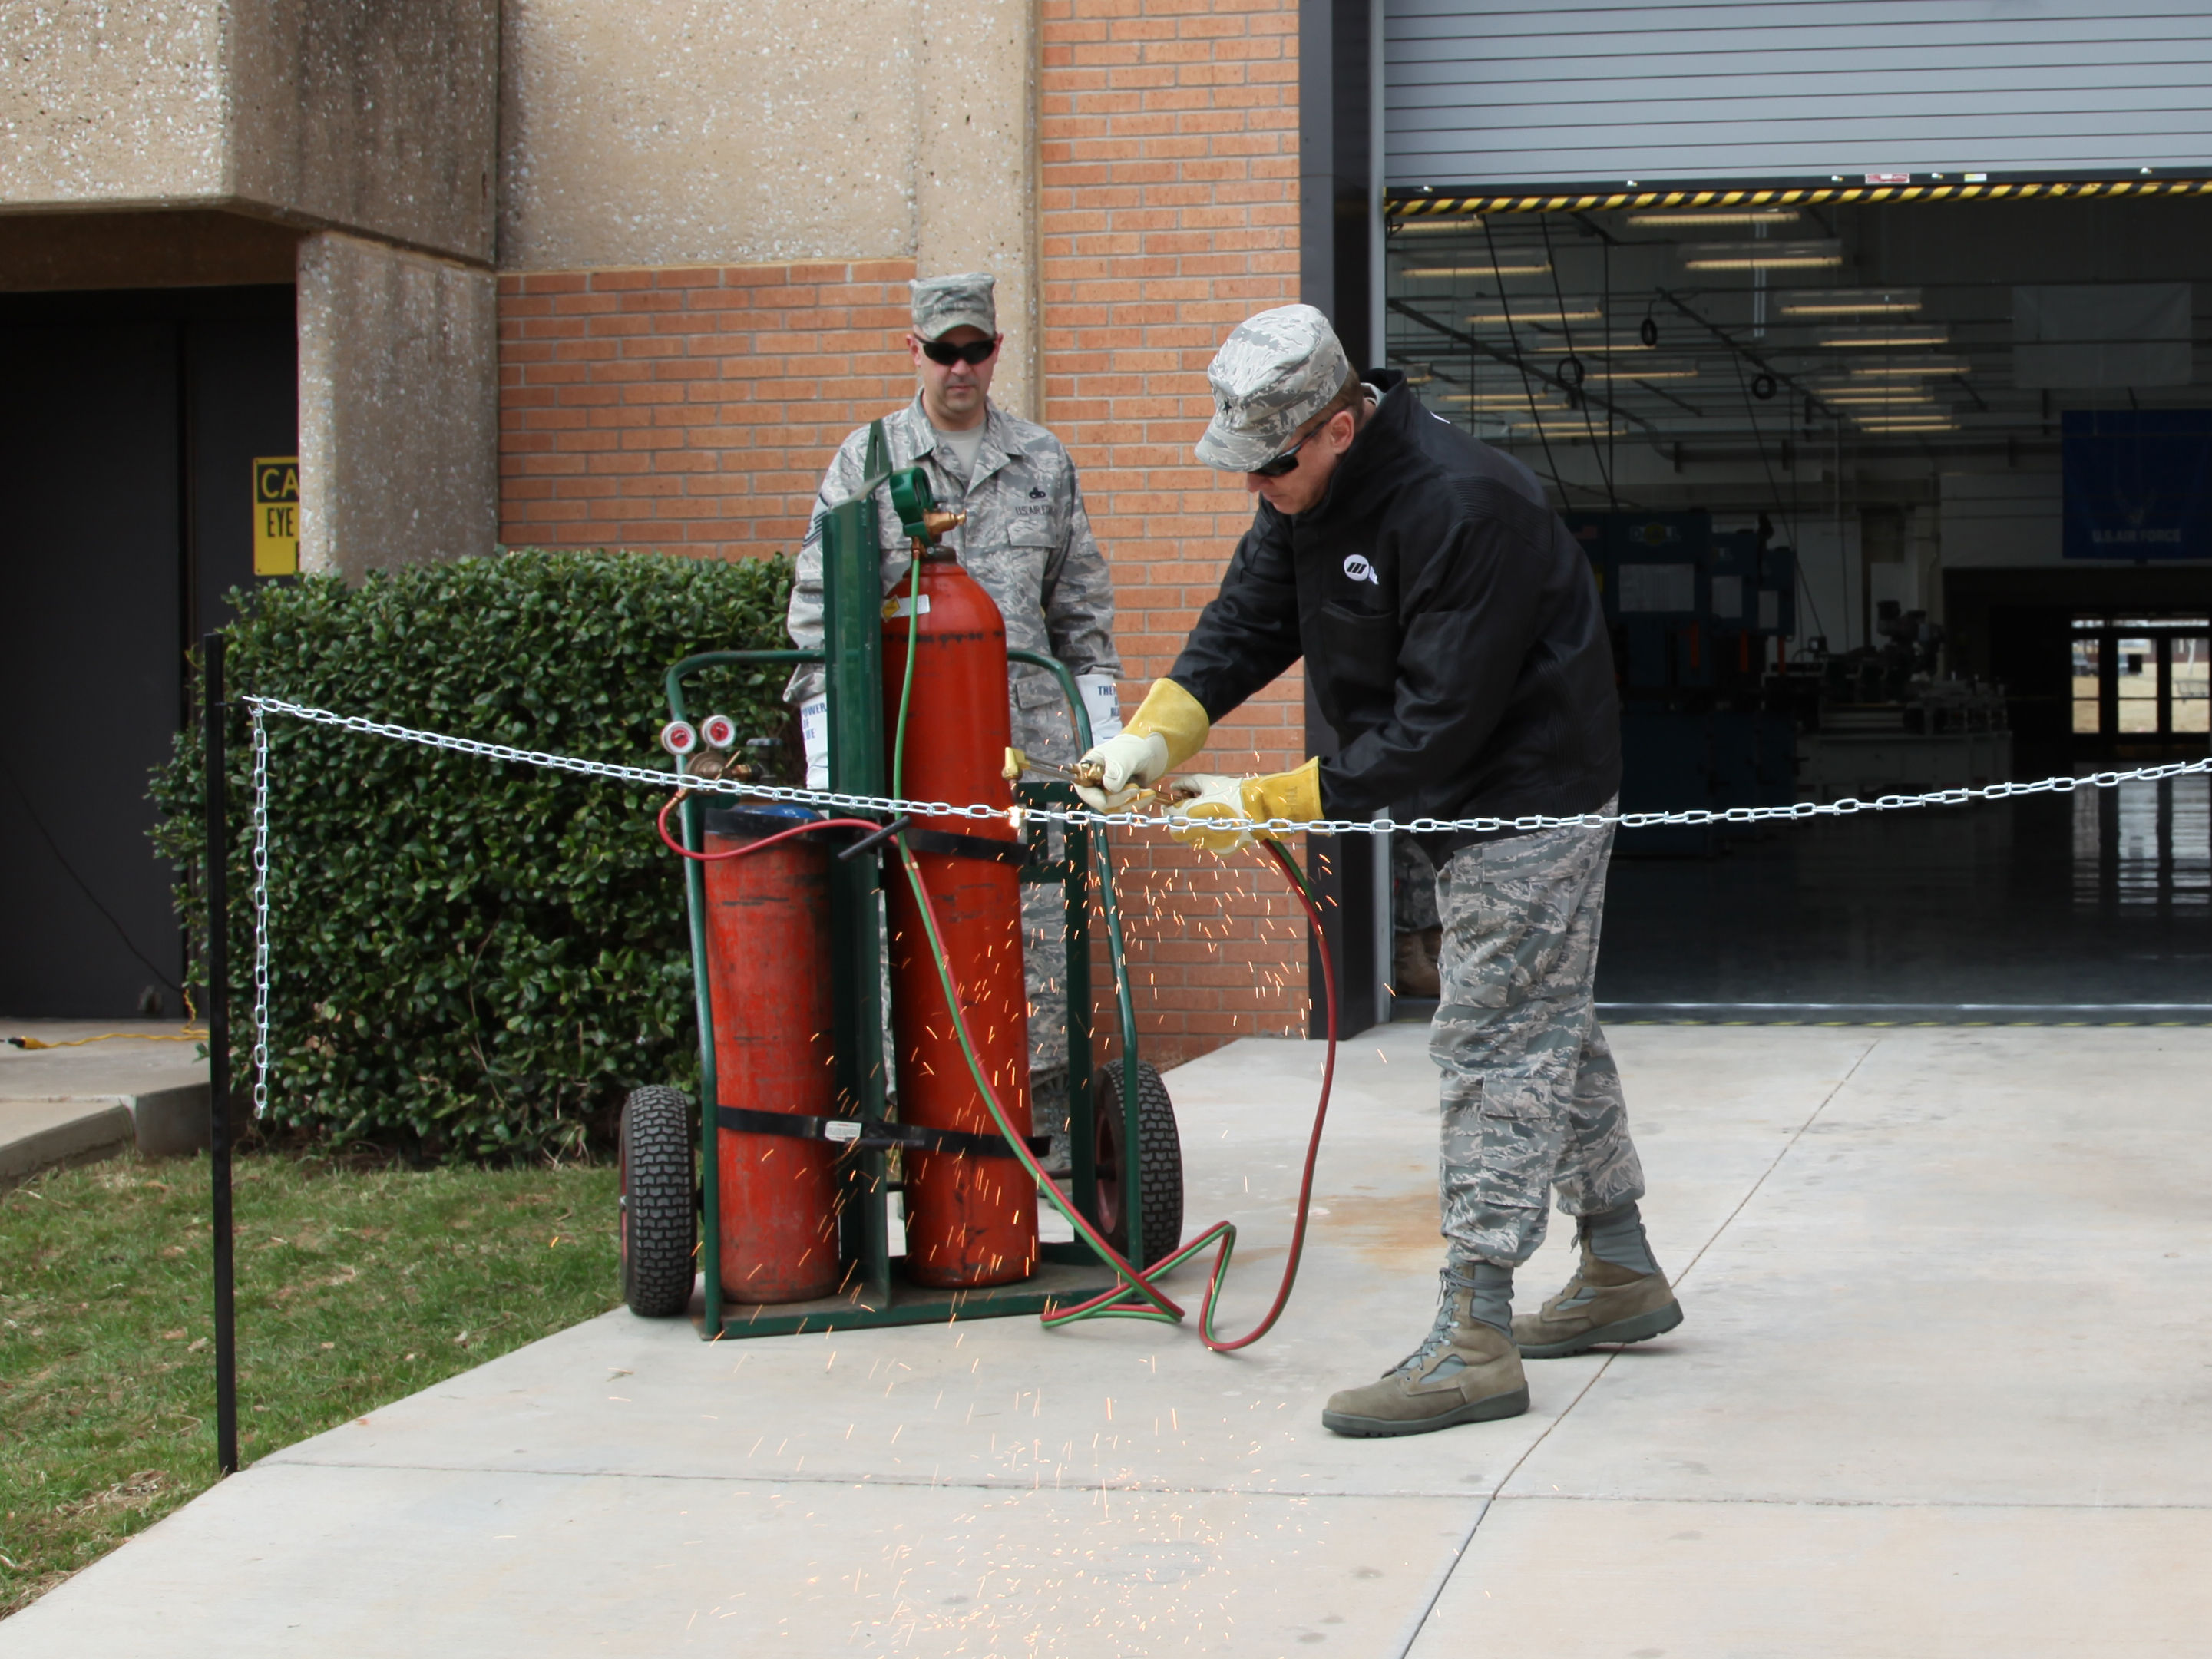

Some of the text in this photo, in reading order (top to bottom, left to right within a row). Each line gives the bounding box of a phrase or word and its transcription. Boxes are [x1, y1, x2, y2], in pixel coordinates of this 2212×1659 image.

[267, 507, 294, 537] EYE
[2140, 528, 2181, 543] FORCE
[802, 702, 828, 718] OWER
